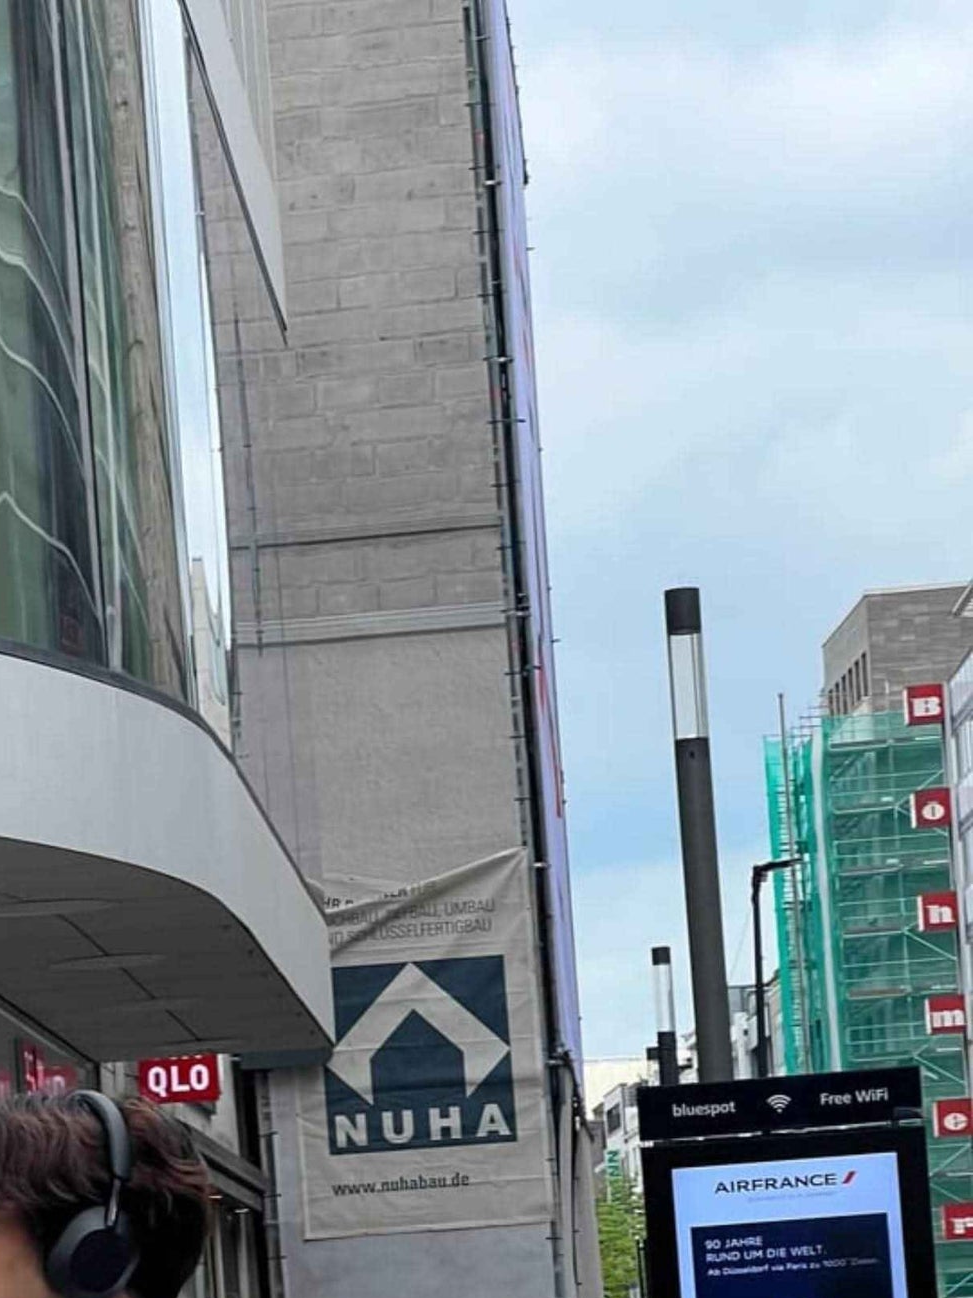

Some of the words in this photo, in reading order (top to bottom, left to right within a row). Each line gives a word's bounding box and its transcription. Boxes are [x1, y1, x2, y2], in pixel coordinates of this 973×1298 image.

[147, 1063, 210, 1098] QLO
[820, 1092, 851, 1106] Free
[856, 1088, 889, 1102] WiFi
[672, 1101, 736, 1117] bluespot
[334, 1103, 512, 1148] NUHA
[331, 1172, 470, 1197] www.nuhabau.de
[714, 1173, 837, 1194] AIRFRANCE
[725, 1236, 763, 1249] JAHRE
[705, 1250, 739, 1263] RUND
[743, 1249, 763, 1261] UM
[766, 1247, 787, 1259] DIE
